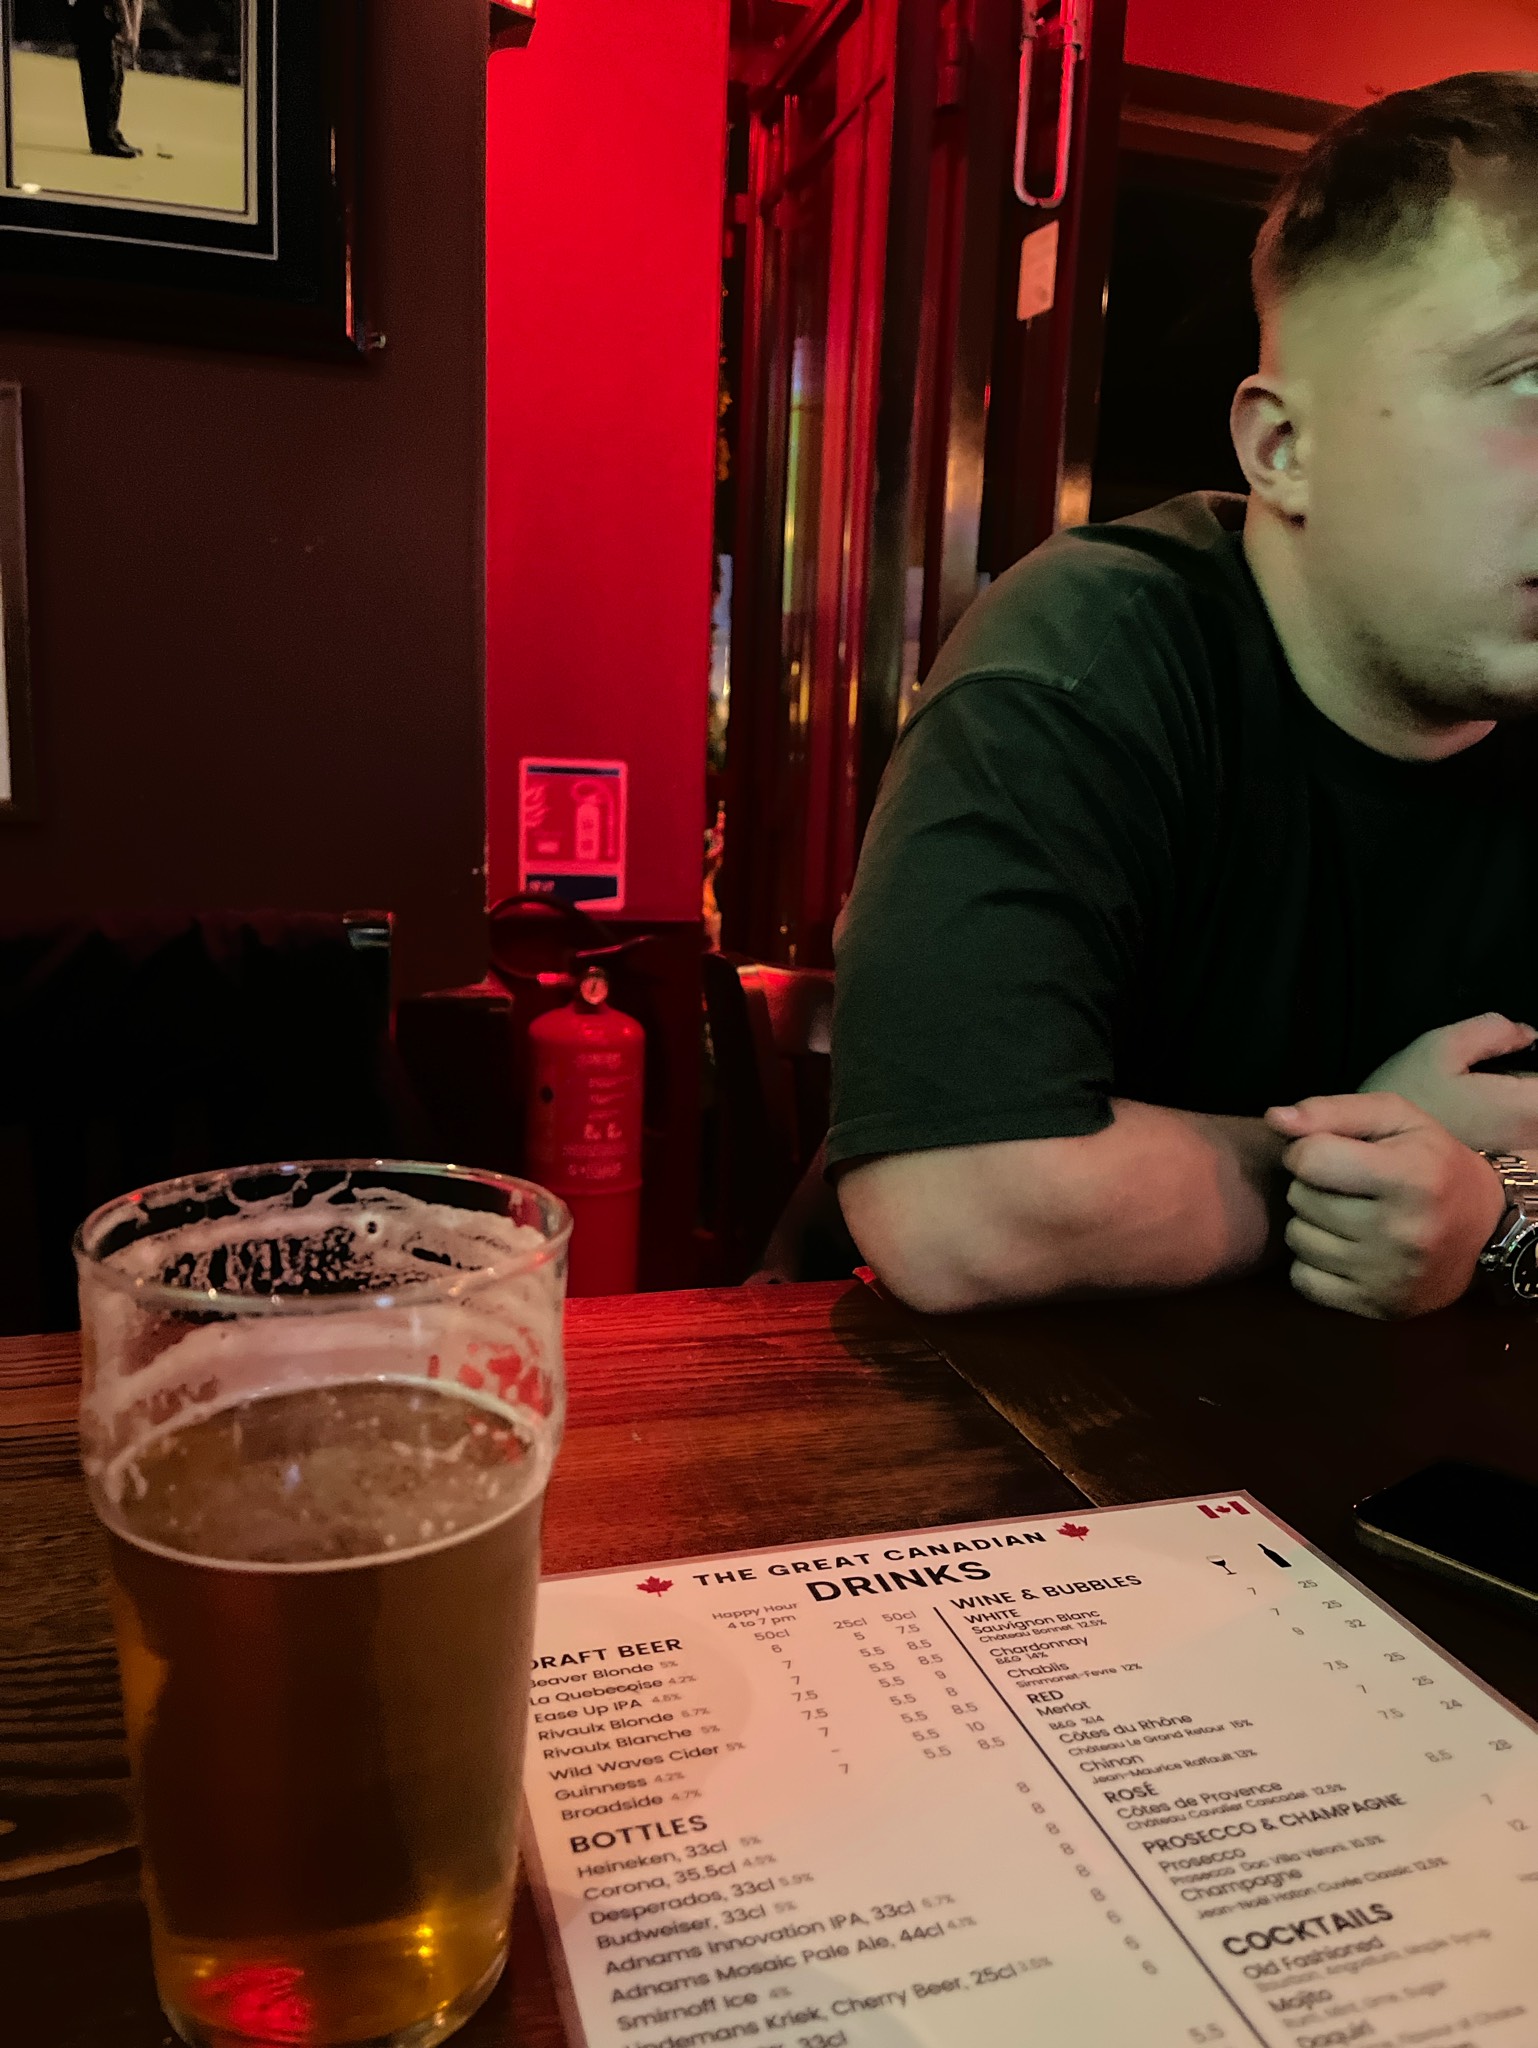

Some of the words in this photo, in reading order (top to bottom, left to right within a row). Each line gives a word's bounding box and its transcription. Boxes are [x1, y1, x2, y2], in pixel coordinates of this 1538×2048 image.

[693, 1569, 757, 1585] THE
[768, 1554, 869, 1575] GREAT
[884, 1531, 1046, 1560] CANADIAN
[806, 1559, 990, 1601] DRINKS
[1247, 1587, 1256, 1596] 7
[1298, 1578, 1319, 1589] 25
[950, 1592, 1016, 1609] WINE
[1021, 1589, 1040, 1600] &
[1042, 1576, 1142, 1597] BUBBLES
[712, 1606, 761, 1620] Happy
[763, 1602, 798, 1613] Hour
[964, 1609, 1020, 1623] WHITE
[1270, 1607, 1280, 1616] 7
[1322, 1599, 1343, 1609] 25
[728, 1621, 737, 1629] 4
[738, 1619, 757, 1628] to
[771, 1614, 796, 1625] pm
[754, 1629, 790, 1641] 50cl
[834, 1618, 867, 1629] 25cl
[882, 1611, 916, 1622] 50cl
[854, 1632, 865, 1640] 5
[896, 1624, 920, 1634] 7.5
[972, 1618, 1055, 1635] Sauvignon
[1056, 1611, 1100, 1622] Blanc
[979, 1631, 1031, 1643] Château
[1032, 1624, 1073, 1635] Bonnet
[1077, 1619, 1107, 1628] 12.5%
[1344, 1618, 1366, 1628] 32
[618, 1639, 682, 1657] BEER
[782, 1660, 792, 1669] 7
[859, 1646, 885, 1657] 5.5
[907, 1639, 932, 1650] 8.5
[990, 1637, 1088, 1659] Chardonnay
[995, 1656, 1021, 1665] B&G
[1026, 1652, 1048, 1660] 14%
[593, 1664, 653, 1679] Blonde
[791, 1676, 800, 1685] 7
[869, 1661, 895, 1672] 5.5
[918, 1654, 943, 1665] 8.5
[1007, 1663, 1069, 1678] Chablis
[1121, 1663, 1143, 1671] 12%
[1323, 1660, 1349, 1671] 7.5
[1384, 1652, 1405, 1662] 25
[792, 1690, 818, 1702] 7.5
[878, 1676, 905, 1687] 5.5
[935, 1670, 947, 1679] 9
[1027, 1690, 1063, 1703] RED
[1356, 1684, 1367, 1694] 7
[1412, 1675, 1434, 1686] 25
[529, 1696, 550, 1706] La
[535, 1710, 578, 1723] Ease
[583, 1704, 608, 1717] Up
[614, 1699, 642, 1710] IPA
[801, 1708, 828, 1720] 7.5
[890, 1694, 916, 1705] 5.5
[946, 1687, 958, 1696] 8
[1036, 1701, 1090, 1716] Merlot
[1440, 1699, 1462, 1710] 24
[538, 1723, 605, 1740] Rivaulx
[610, 1713, 673, 1729] Blonde
[819, 1727, 828, 1737] 7
[900, 1711, 928, 1723] 5.5
[952, 1702, 978, 1714] 8.5
[912, 1729, 939, 1741] 5.5
[966, 1721, 985, 1732] 10
[1049, 1719, 1076, 1731] B&G
[1059, 1729, 1110, 1743] Côtes
[1113, 1724, 1137, 1735] du
[1138, 1716, 1192, 1730] Rhône
[543, 1741, 610, 1759] Rivaulx
[616, 1729, 692, 1747] Blanche
[1126, 1738, 1141, 1747] Le
[1143, 1731, 1184, 1743] Grand
[1184, 1725, 1224, 1736] Retour
[549, 1765, 592, 1780] Wild
[597, 1756, 664, 1772] Waves
[669, 1746, 718, 1761] Cider
[839, 1764, 849, 1774] 7
[923, 1746, 951, 1759] 5.5
[977, 1737, 1005, 1749] 8.5
[1080, 1755, 1144, 1772] Chinon
[1092, 1758, 1182, 1784] Jean-Maurice
[555, 1778, 647, 1800] Guinness
[1017, 1782, 1030, 1793] 8
[1104, 1782, 1159, 1803] ROSÉ
[561, 1795, 663, 1821] Broadside
[1032, 1802, 1045, 1814] 8
[1117, 1803, 1171, 1819] Côtes
[1174, 1796, 1198, 1809] de
[1199, 1783, 1282, 1804] Provence
[1188, 1803, 1243, 1818] Cavalier
[570, 1815, 707, 1853] BOTTLES
[1046, 1823, 1060, 1835] 8
[1142, 1822, 1257, 1854] PROSECCO
[1260, 1818, 1278, 1831] &
[1279, 1791, 1406, 1826] CHAMPAGNE
[577, 1852, 681, 1878] Heineken,
[685, 1840, 727, 1858] 33cl
[1060, 1843, 1074, 1855] 8
[1158, 1848, 1246, 1873] Prosecco
[583, 1877, 670, 1901] Corona,
[674, 1861, 736, 1884] 35.5cl
[1076, 1864, 1091, 1877] 8
[1180, 1867, 1303, 1902] Champagne
[589, 1891, 727, 1925] Desperados,
[731, 1878, 775, 1897] 33cl
[596, 1918, 717, 1949] Budweiser,
[722, 1904, 766, 1924] 33cl
[606, 1946, 703, 1975] Adnams
[707, 1922, 825, 1954] Innovation
[829, 1912, 869, 1929] IPA,
[871, 1901, 916, 1920] 33cl
[1222, 1904, 1393, 1956] COCKTAILS
[611, 1973, 710, 2003] Adnams
[715, 1956, 797, 1981] Mosaic
[802, 1945, 850, 1963] Pale
[857, 1937, 895, 1952] Ale,
[900, 1923, 944, 1942] 44cl
[1243, 1961, 1281, 1979] Old
[1281, 1936, 1385, 1970] Fashioned
[831, 1990, 906, 2016] Cherry
[912, 1978, 968, 1999] Beer,
[970, 1964, 1017, 1985] 25cl
[617, 1997, 717, 2031] Smirnoff
[723, 1993, 758, 2008] Ice
